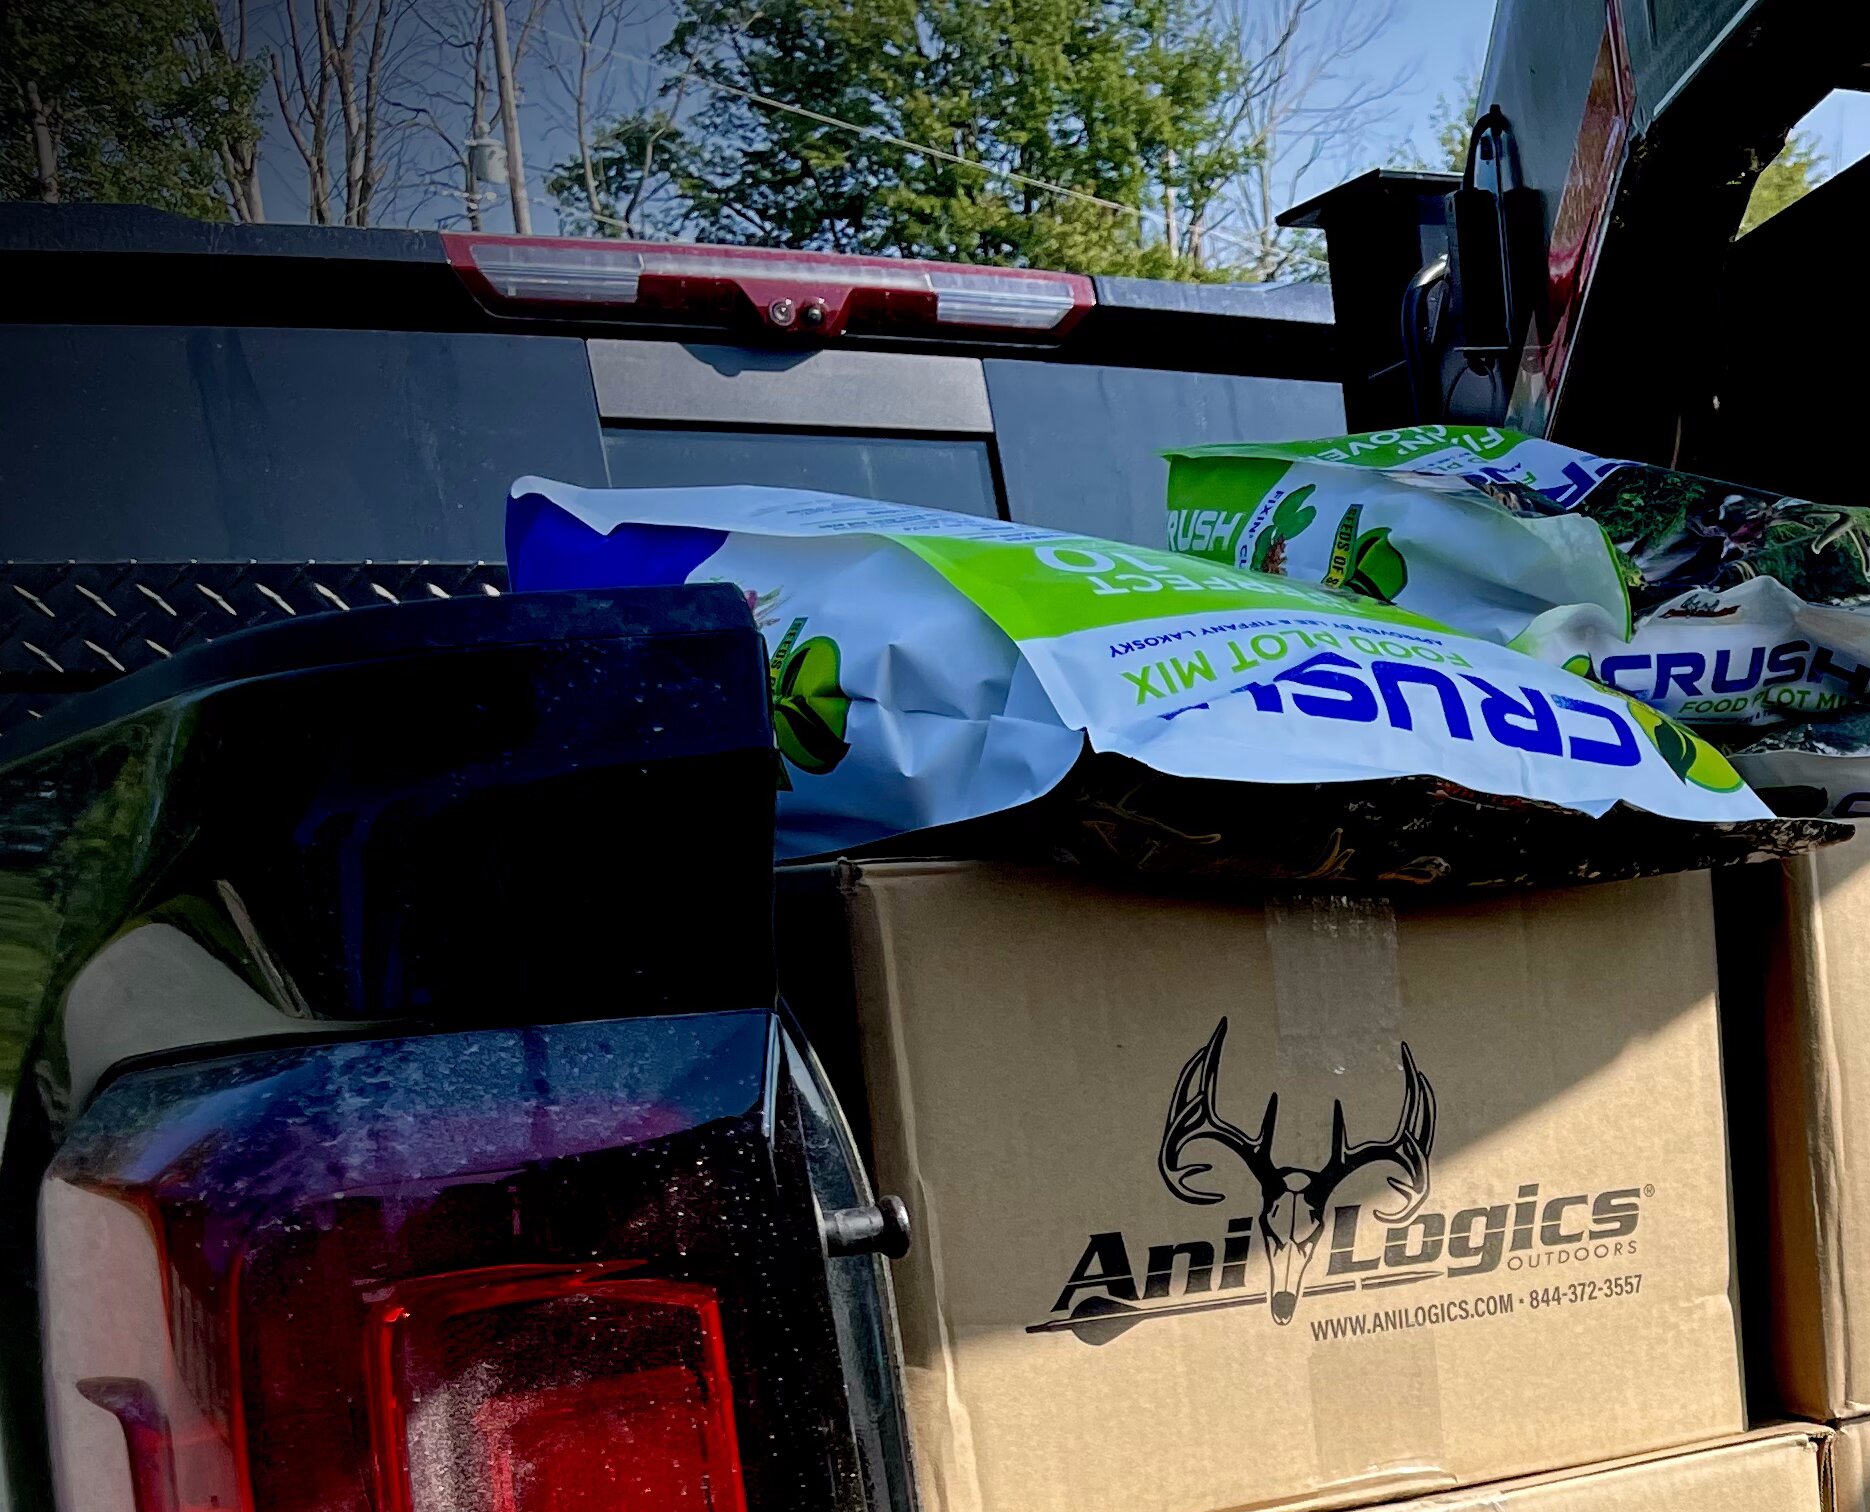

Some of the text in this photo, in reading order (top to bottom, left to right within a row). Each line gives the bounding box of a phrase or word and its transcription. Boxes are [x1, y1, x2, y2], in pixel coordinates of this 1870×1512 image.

[1312, 425, 1447, 462] CLOVE
[1168, 509, 1246, 552] RUSH
[1034, 544, 1170, 574] 10
[1109, 629, 1198, 658] LAKOSKY
[1201, 619, 1277, 637] TIFFANY
[1119, 630, 1474, 706] FOOD PLOT MIX
[1157, 651, 1642, 767] CRUS
[1678, 697, 1749, 714] FOOD
[1815, 691, 1852, 711] MI
[1051, 1182, 1642, 1313] Ani Logics
[1506, 1239, 1639, 1272] OUTDOORS
[1310, 1273, 1644, 1343] WWW.ANILOGICS.COM 844-372-3557
